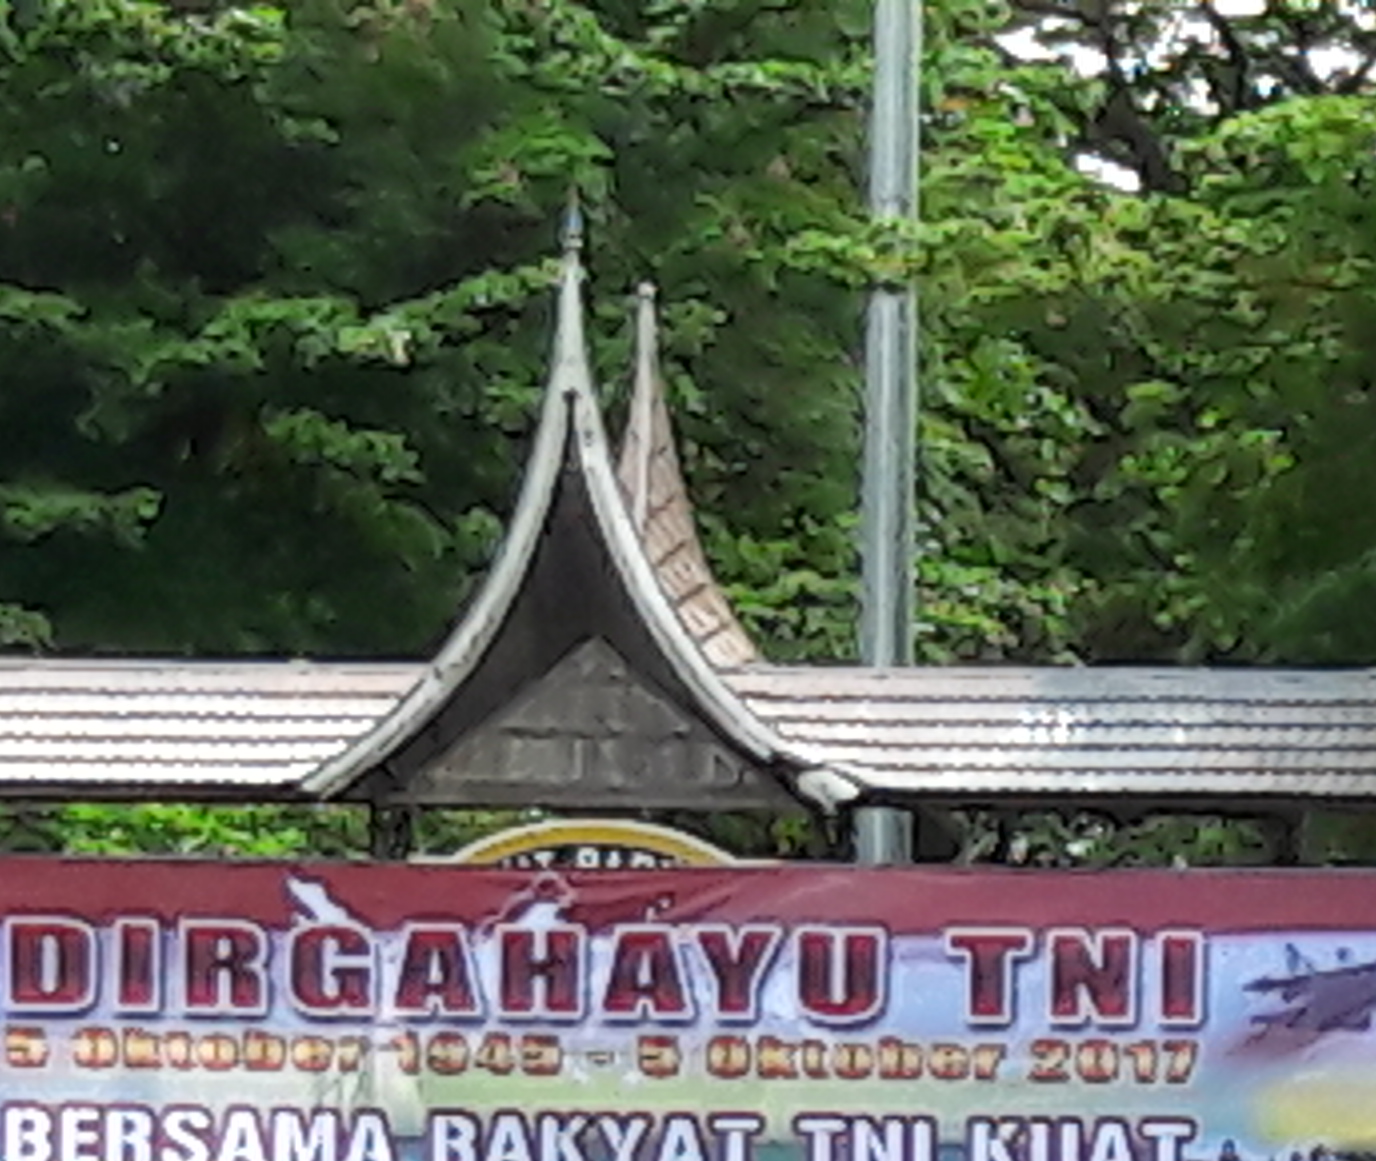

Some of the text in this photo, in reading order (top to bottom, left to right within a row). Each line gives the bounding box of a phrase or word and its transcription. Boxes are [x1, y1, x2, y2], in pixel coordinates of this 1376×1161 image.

[5, 918, 1209, 1028] DIRGAHAYU TNI
[4, 1025, 47, 1068] 5
[73, 1026, 370, 1072] Oktober
[398, 1032, 562, 1077] 1945
[639, 1036, 680, 1077] 5
[706, 1036, 1005, 1081] Oktober
[1028, 1038, 1200, 1083] 2017
